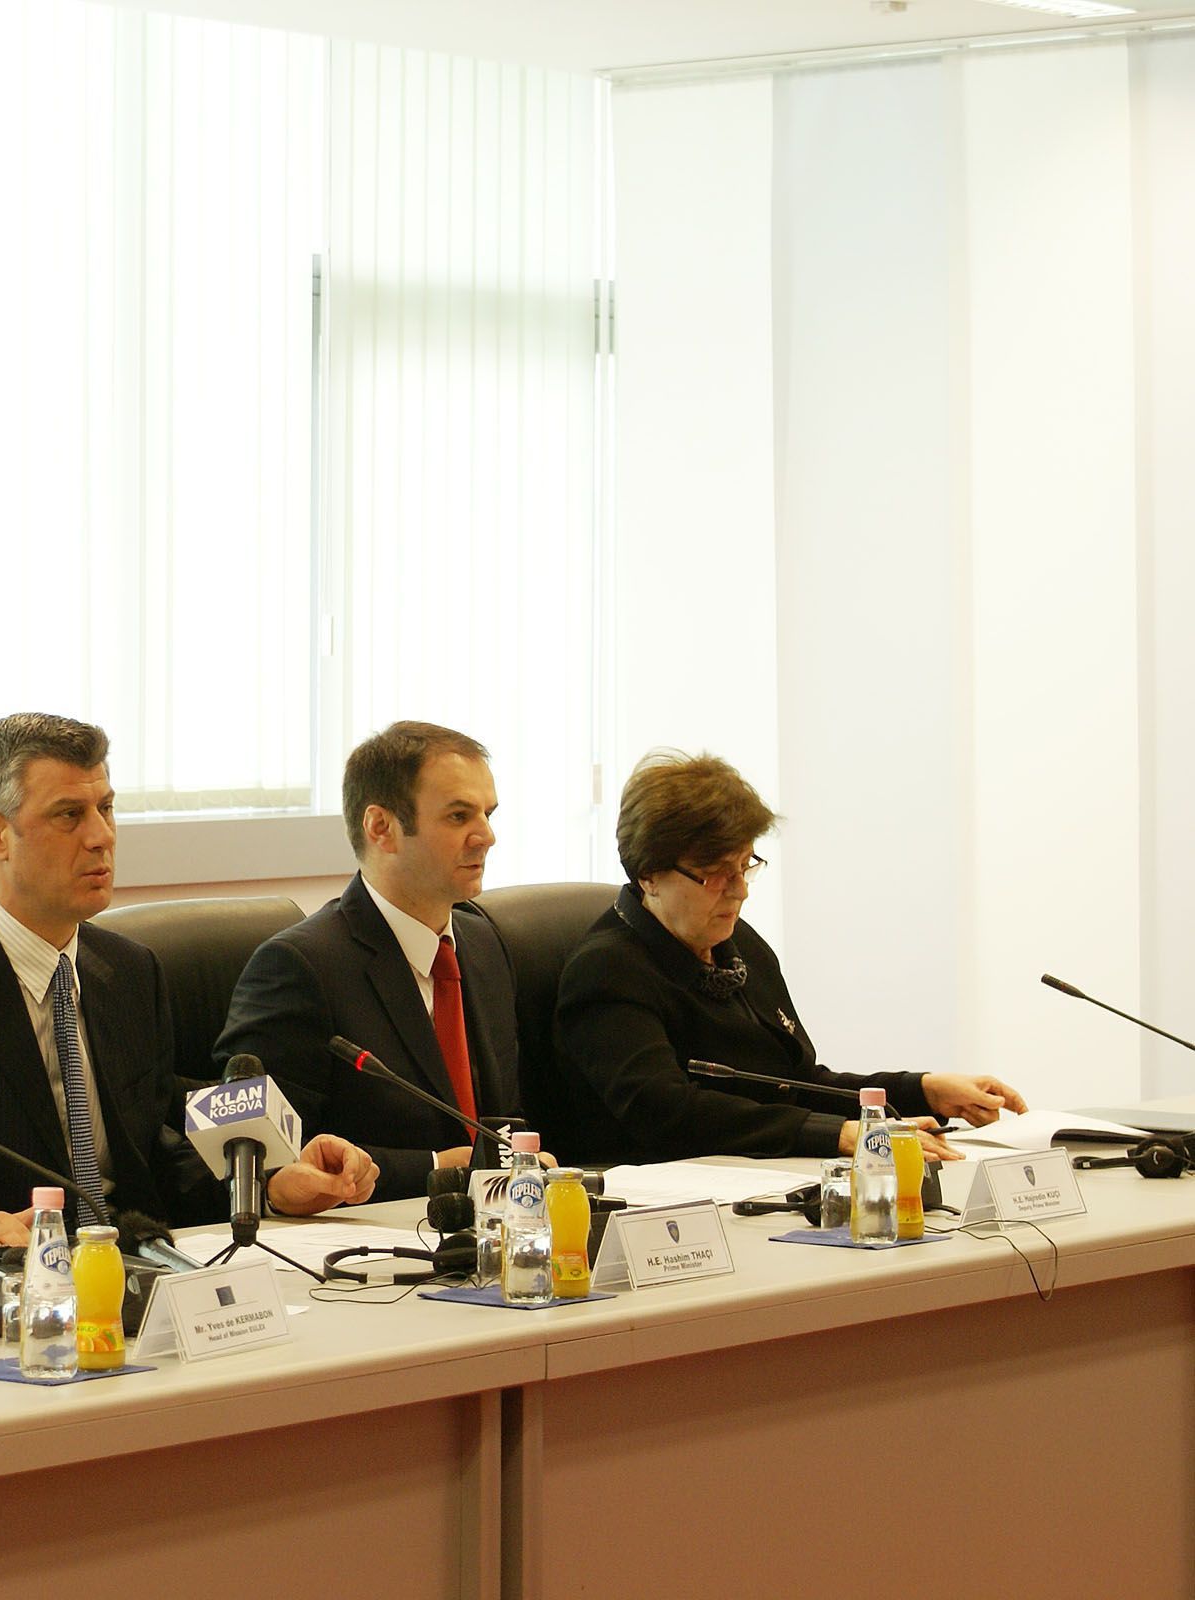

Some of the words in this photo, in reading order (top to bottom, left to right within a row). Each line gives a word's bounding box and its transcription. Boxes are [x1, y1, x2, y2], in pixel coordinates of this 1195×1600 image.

[210, 1085, 263, 1109] KLAN
[209, 1100, 263, 1119] KOSOVA
[647, 1256, 663, 1267] H.E.
[663, 1252, 691, 1265] Hashim
[691, 1249, 713, 1262] THAÇI
[663, 1263, 680, 1272] Prime
[681, 1261, 703, 1270] Minister
[194, 1325, 207, 1334] Mr.
[207, 1321, 225, 1331] Yves
[226, 1319, 235, 1327] de
[235, 1309, 274, 1325] KERMABON
[208, 1333, 223, 1341] Head
[223, 1331, 229, 1339] of
